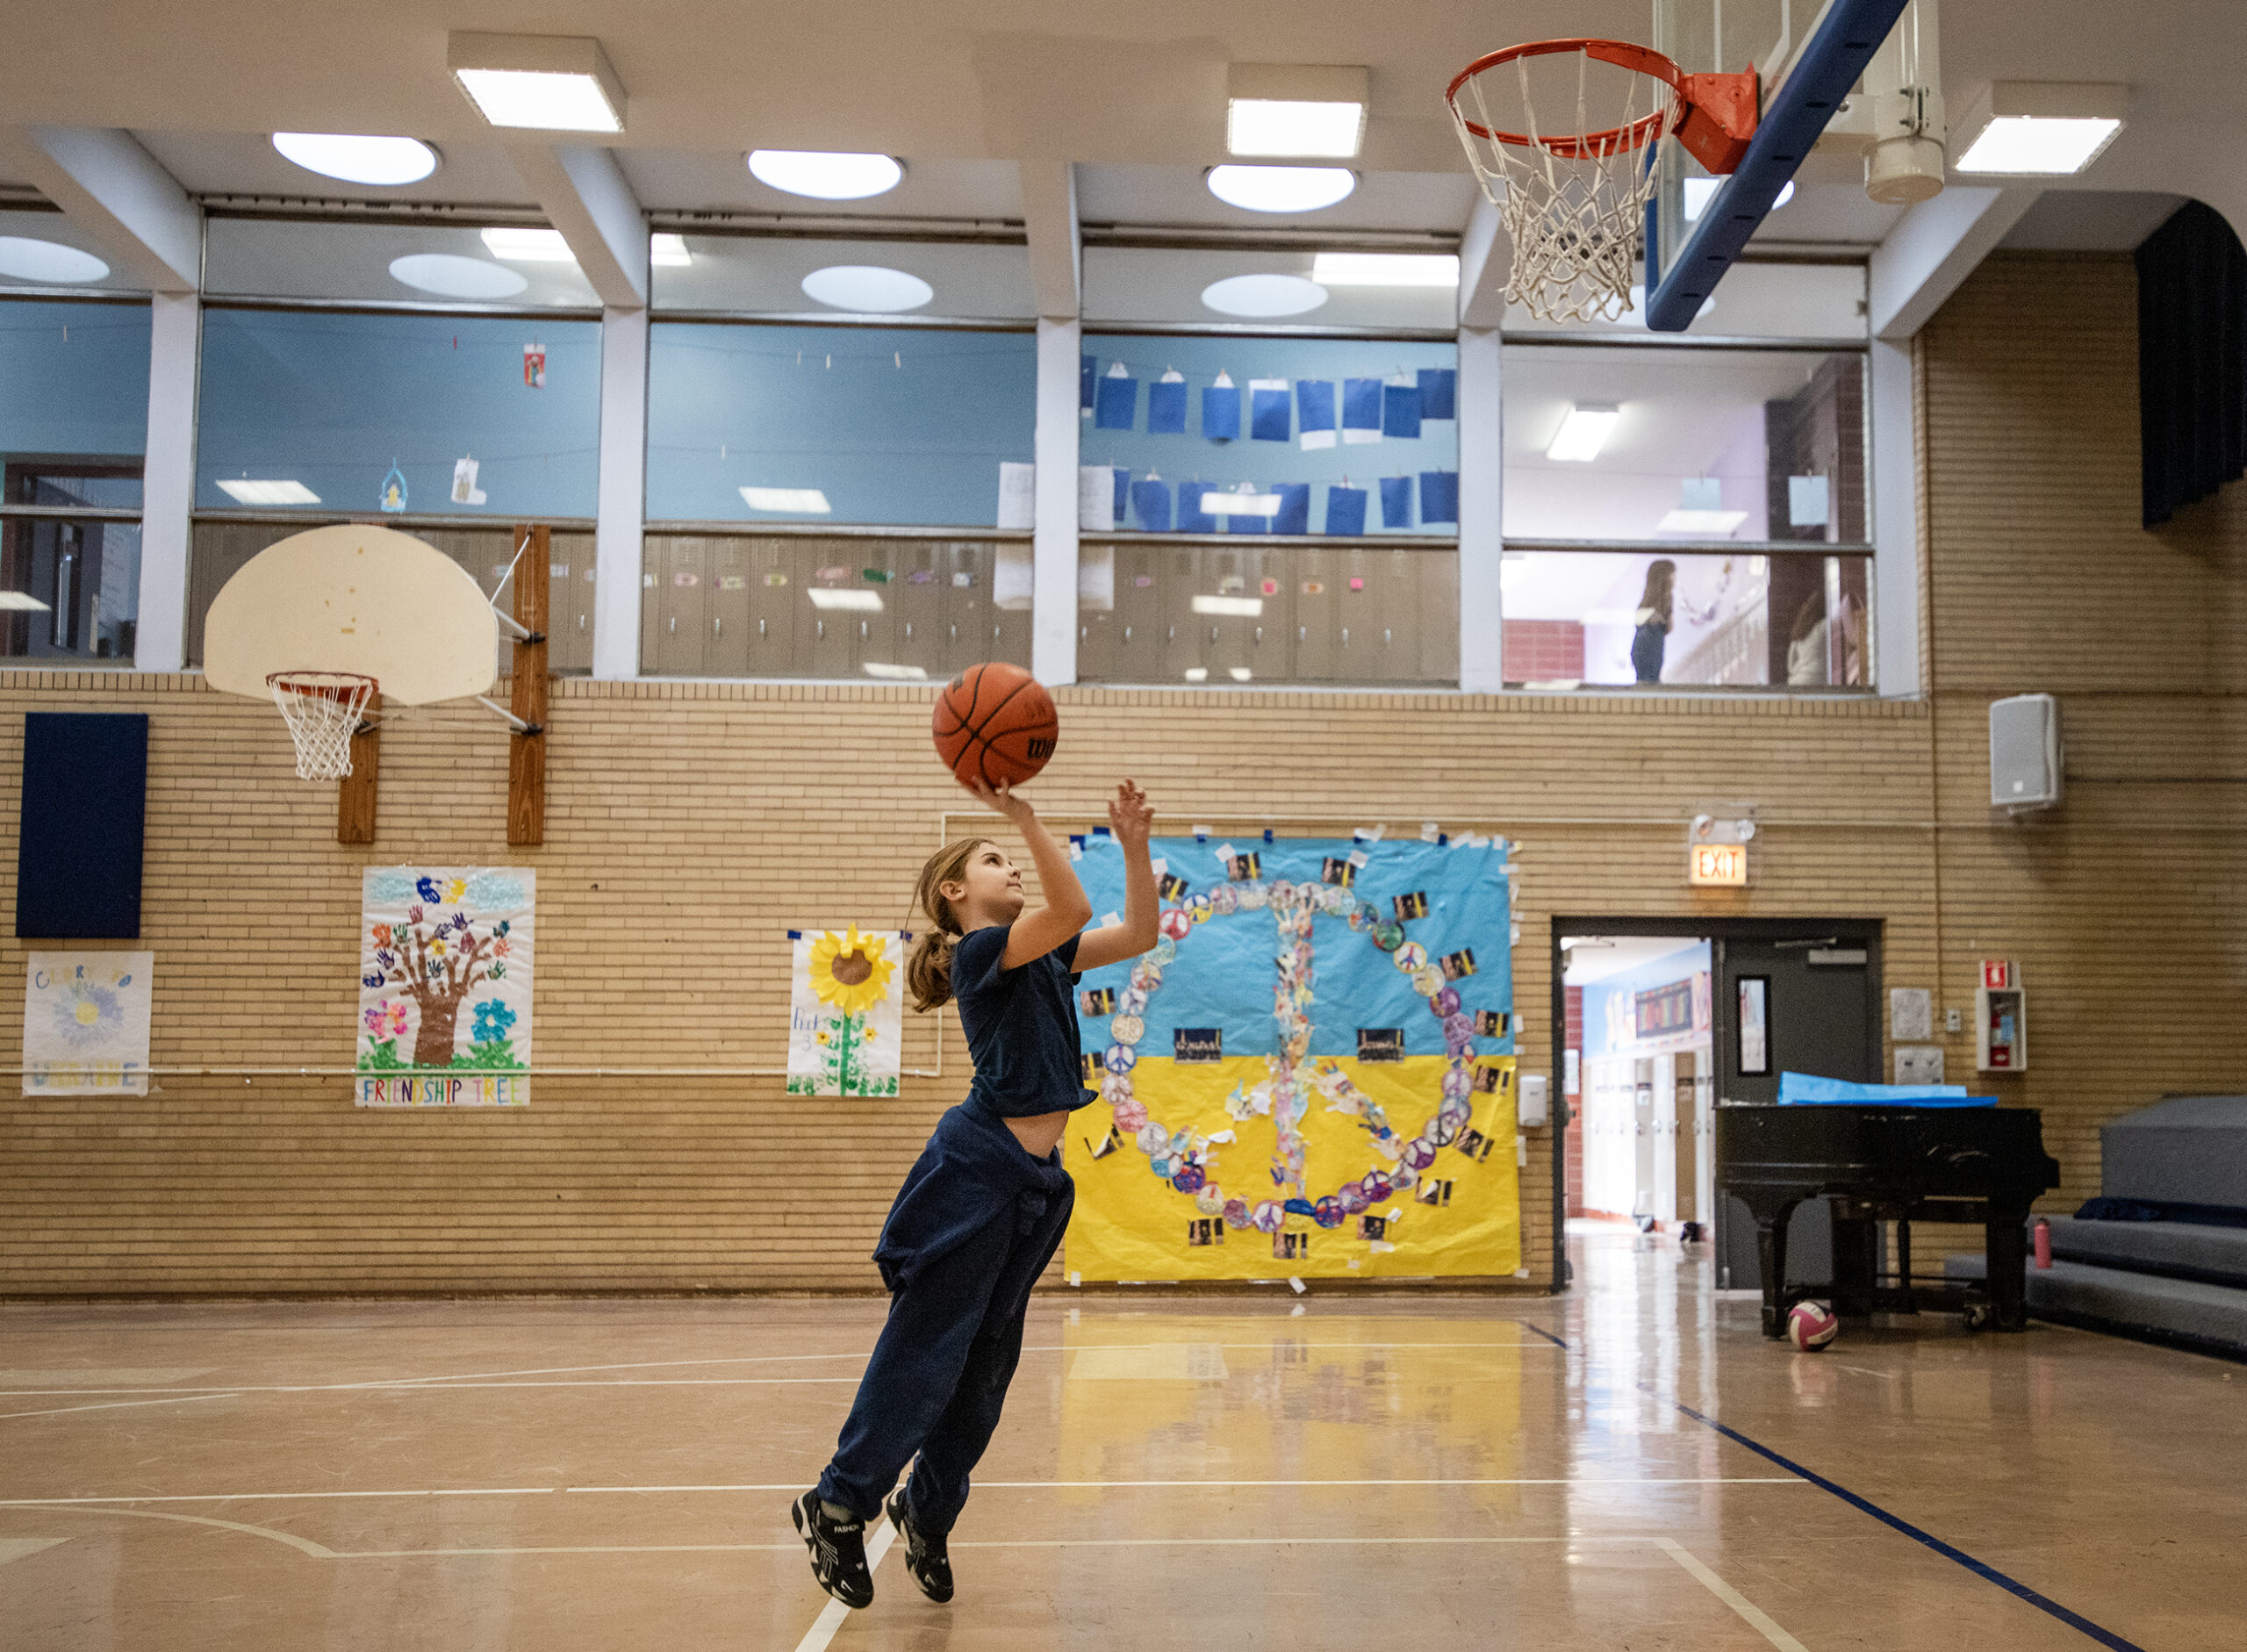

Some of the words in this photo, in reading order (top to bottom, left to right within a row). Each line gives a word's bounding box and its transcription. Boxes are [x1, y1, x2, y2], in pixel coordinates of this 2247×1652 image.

[1699, 851, 1739, 878] EXIT
[363, 1079, 463, 1106] FRIENDSHIP
[473, 1077, 523, 1105] TREE
